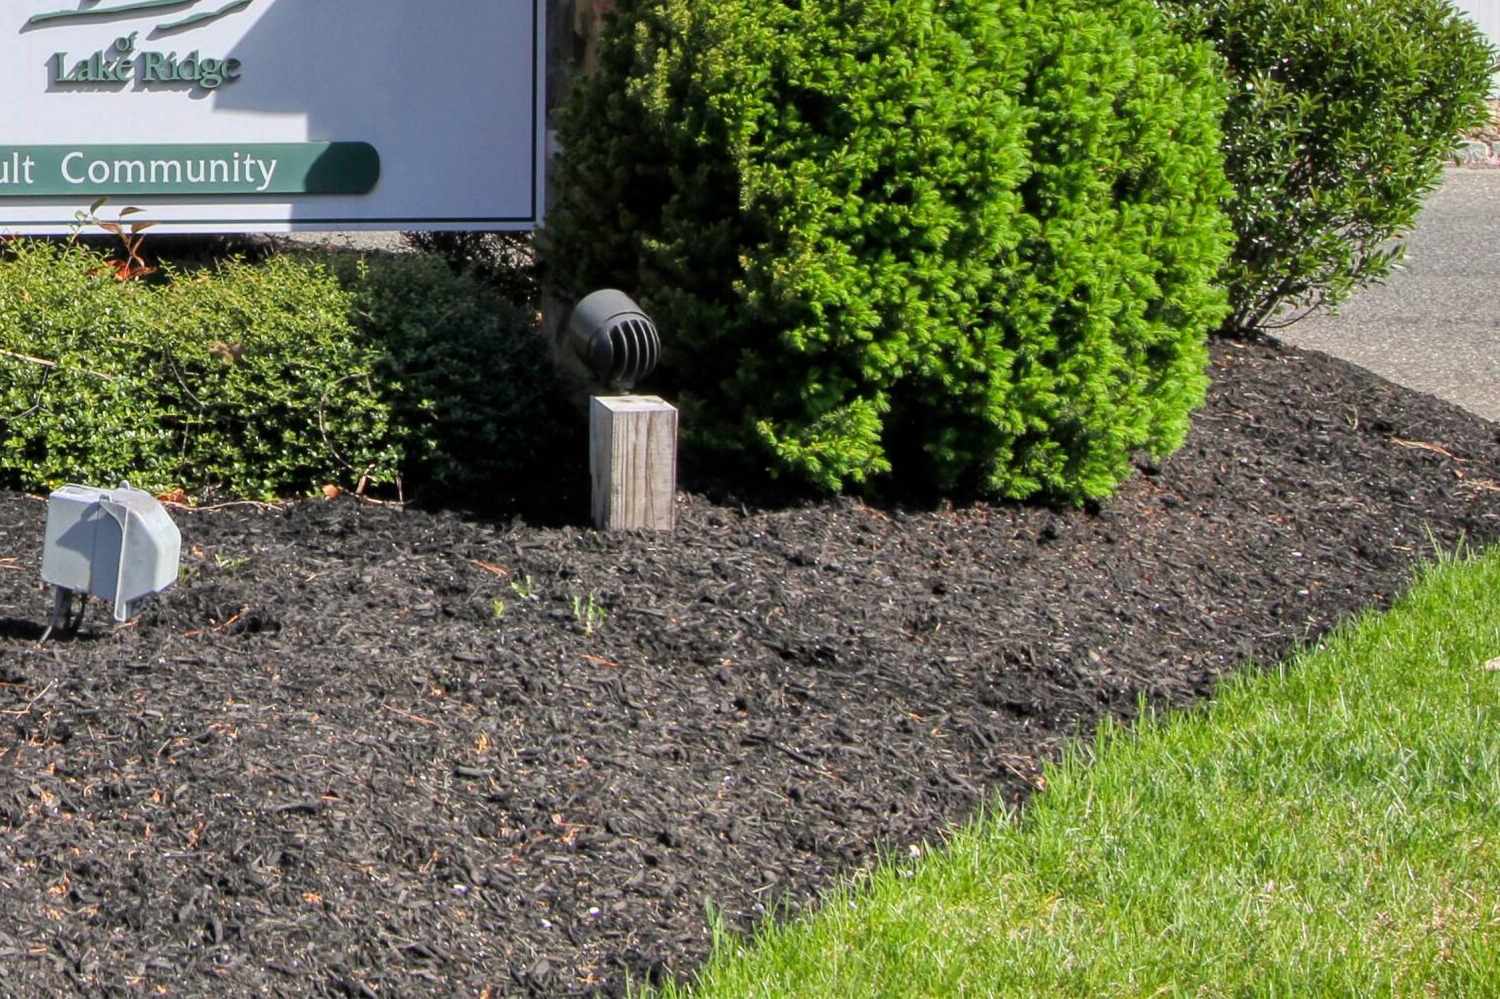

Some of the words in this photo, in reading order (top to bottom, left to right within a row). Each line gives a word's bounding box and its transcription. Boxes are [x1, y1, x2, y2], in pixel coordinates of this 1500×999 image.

[114, 30, 140, 52] of
[55, 50, 135, 82] Lake
[142, 49, 243, 89] Ridge
[60, 150, 278, 192] Community
